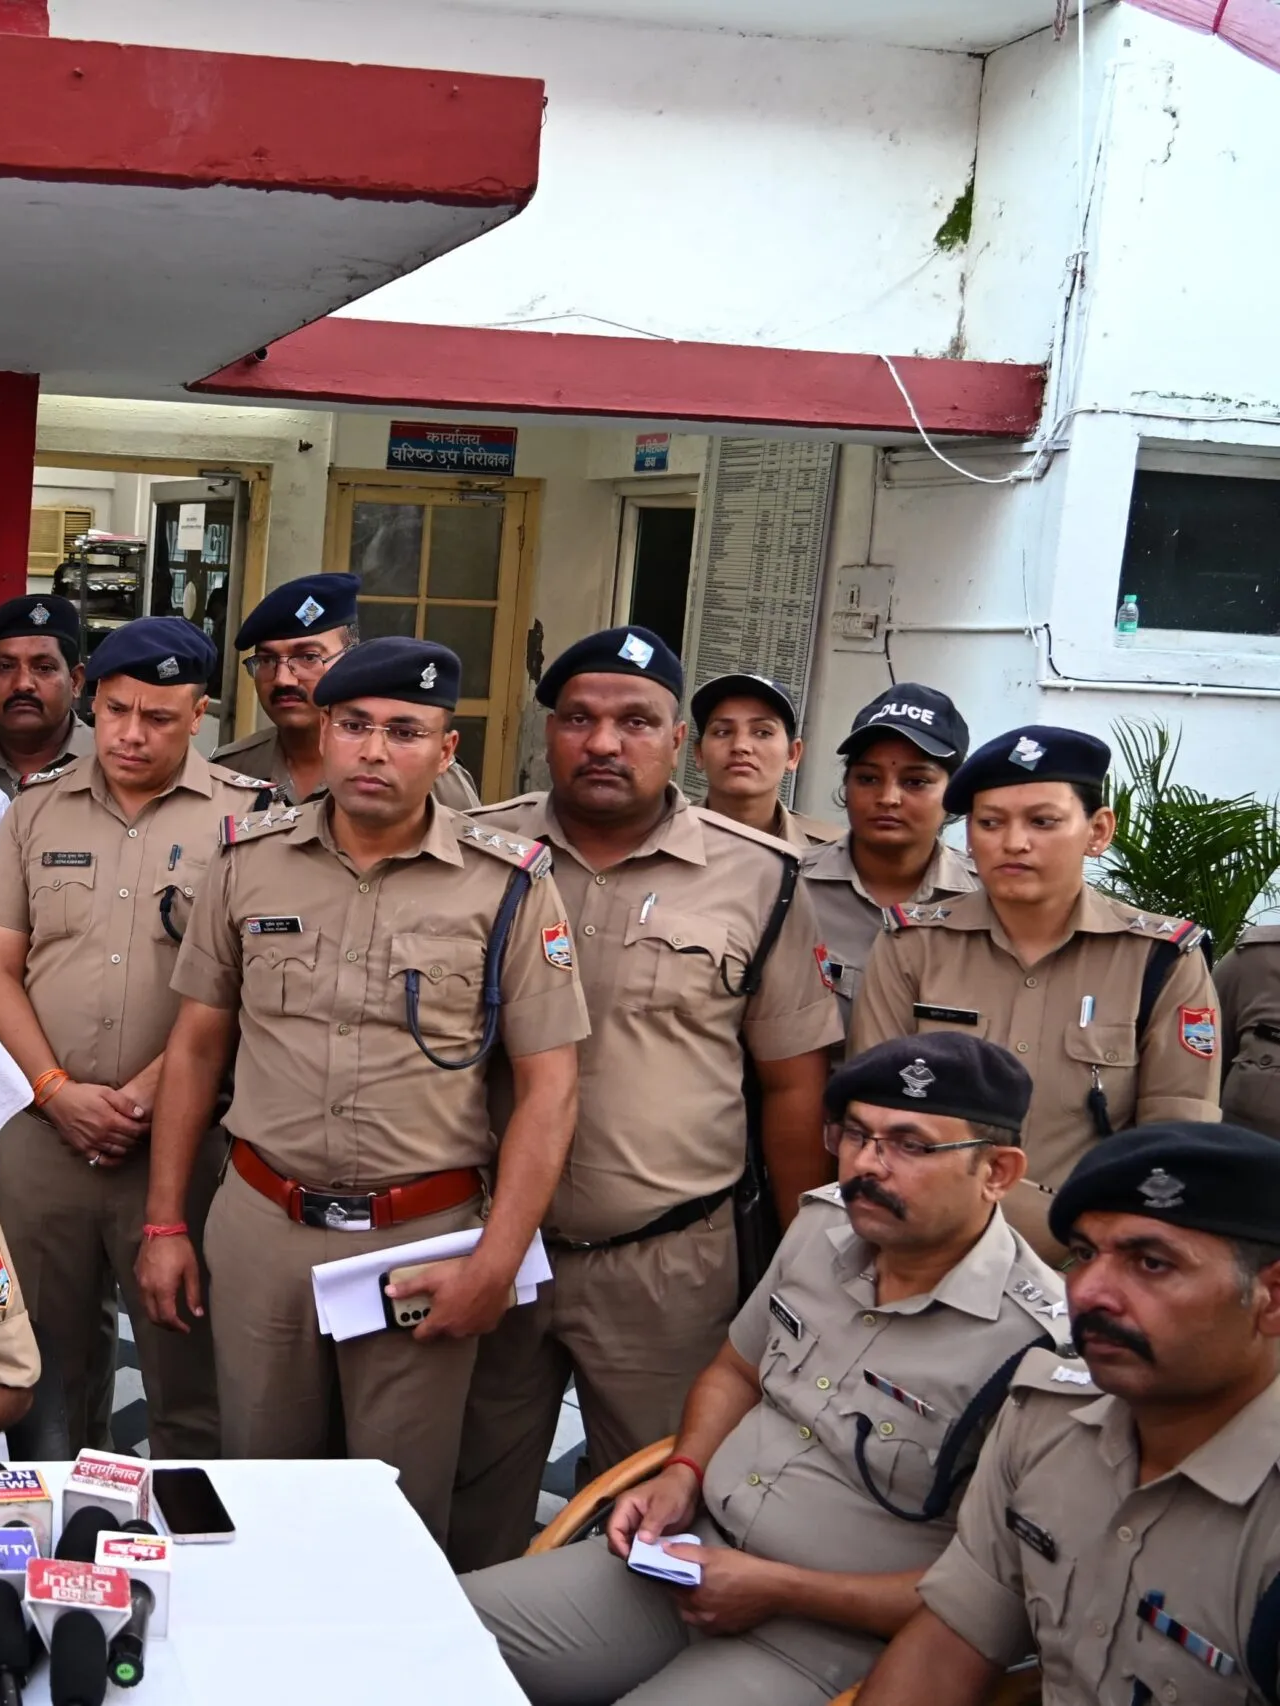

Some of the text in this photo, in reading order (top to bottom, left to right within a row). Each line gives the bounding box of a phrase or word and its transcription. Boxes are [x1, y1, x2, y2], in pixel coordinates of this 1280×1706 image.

[425, 429, 481, 446] कार्यालय
[391, 442, 434, 463] वरिष्ठ
[463, 446, 511, 467] निरीक्षक
[868, 703, 935, 726] POLICE
[10, 1544, 33, 1556] TV
[42, 1570, 113, 1593] India
